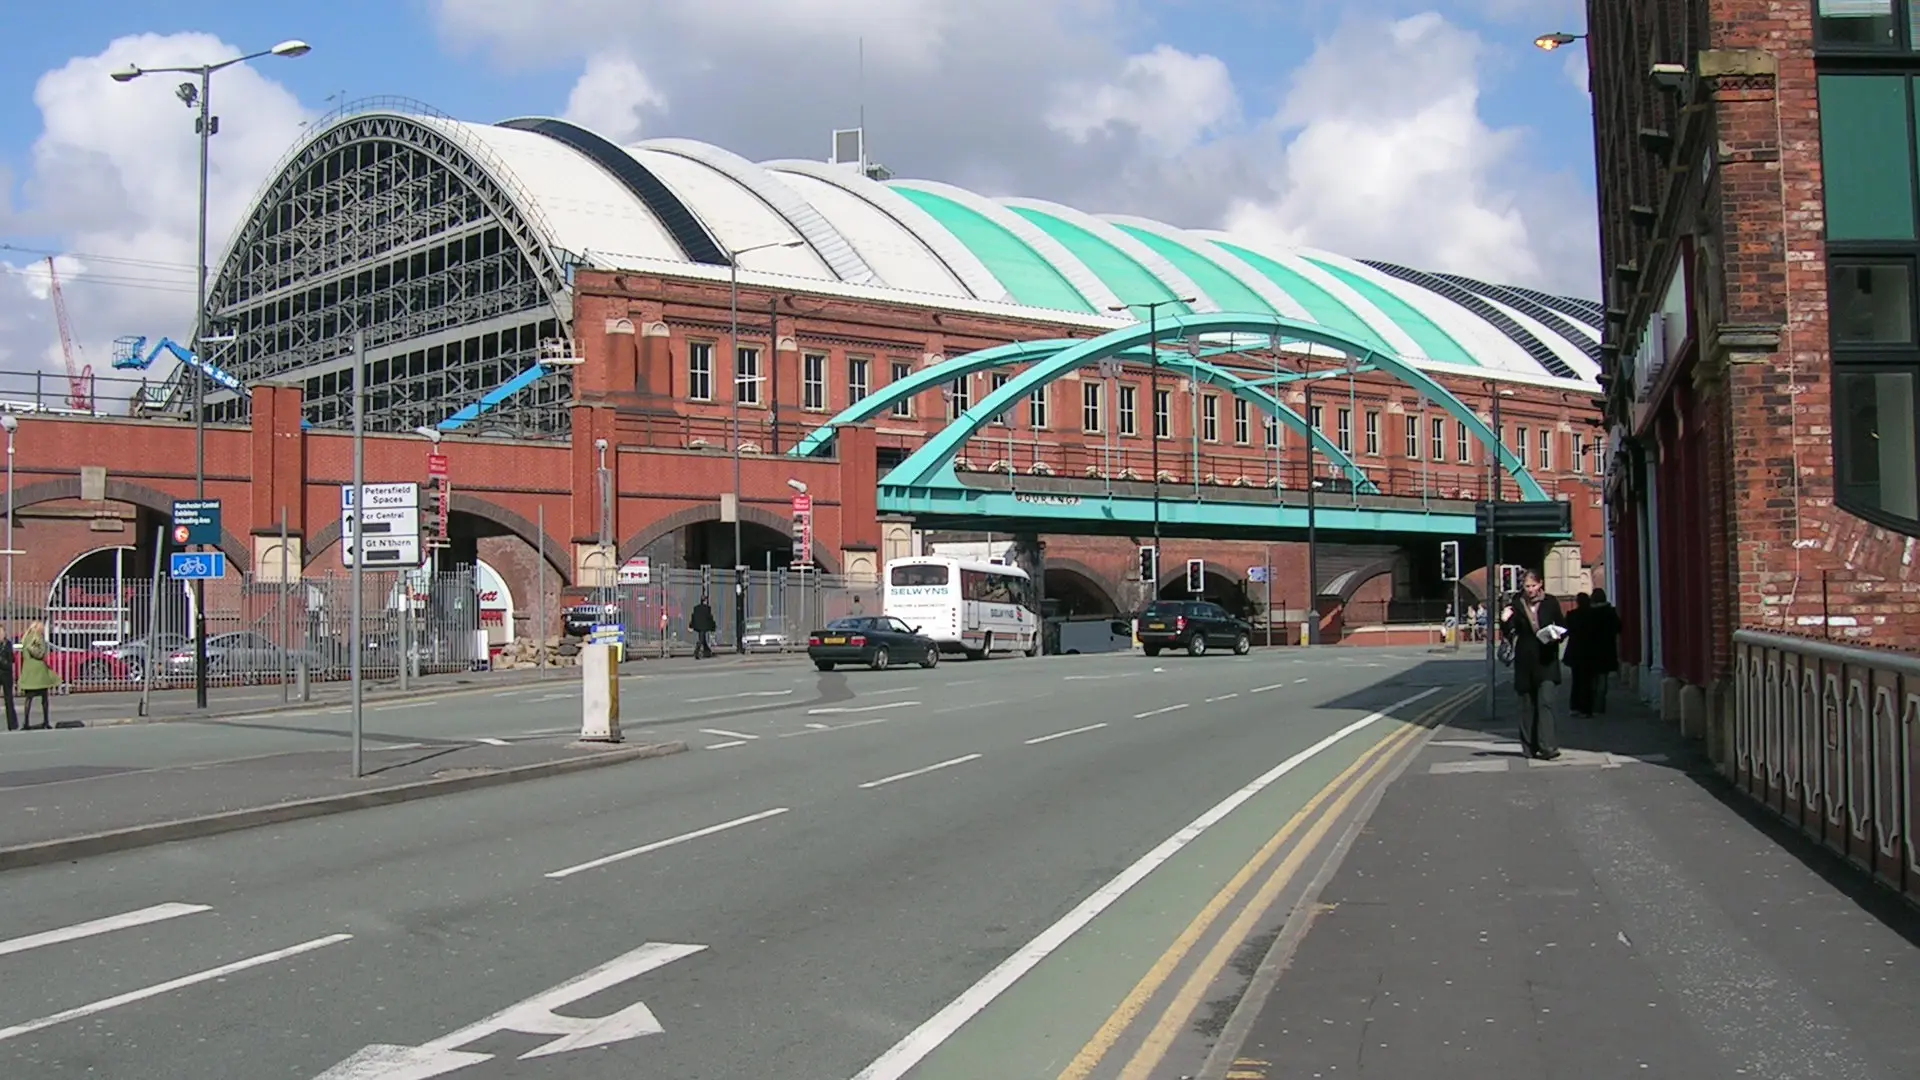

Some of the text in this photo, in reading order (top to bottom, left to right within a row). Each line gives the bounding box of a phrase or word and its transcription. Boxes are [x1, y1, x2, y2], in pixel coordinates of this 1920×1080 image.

[365, 486, 411, 494] Petersfield
[372, 496, 403, 504] Spaces
[376, 511, 405, 519] Central
[890, 587, 949, 595] SELWYNS
